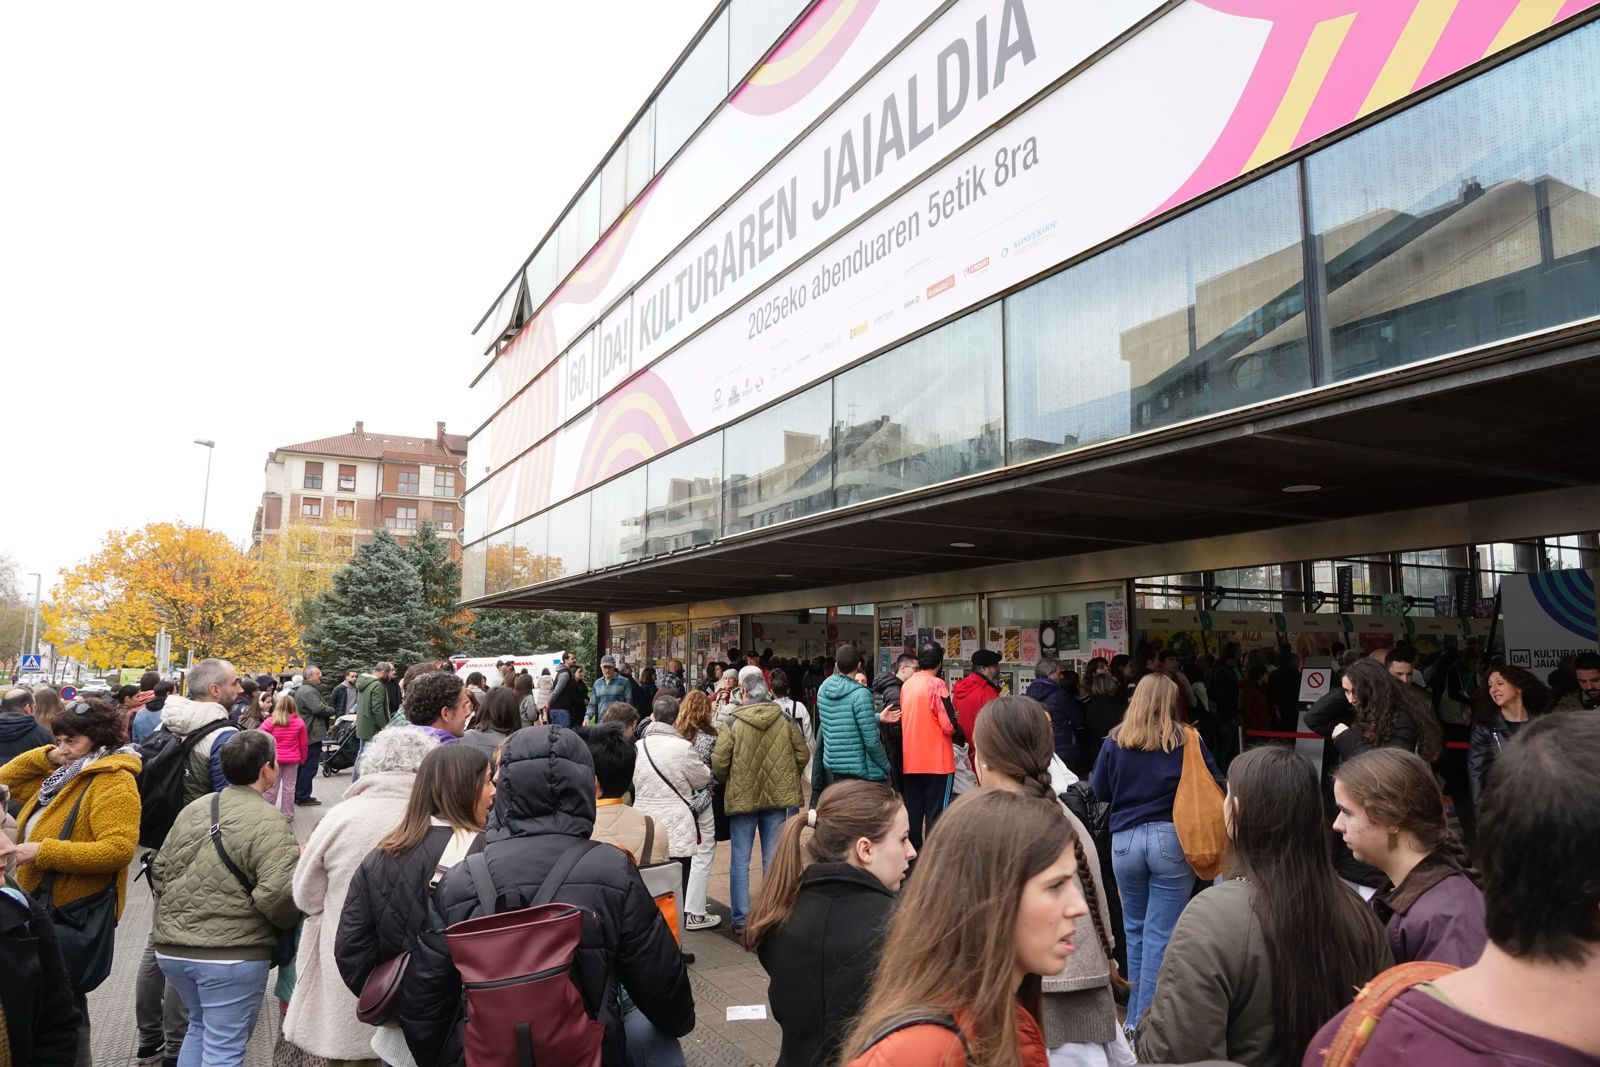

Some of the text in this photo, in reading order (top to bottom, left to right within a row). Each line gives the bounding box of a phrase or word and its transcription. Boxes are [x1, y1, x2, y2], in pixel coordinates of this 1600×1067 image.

[569, 0, 1037, 402] 60. DA! KULTURAREN JAIALDIA
[748, 135, 1039, 340] 2025eko abenduaren 5etik 8ra
[1513, 655, 1528, 663] DA!
